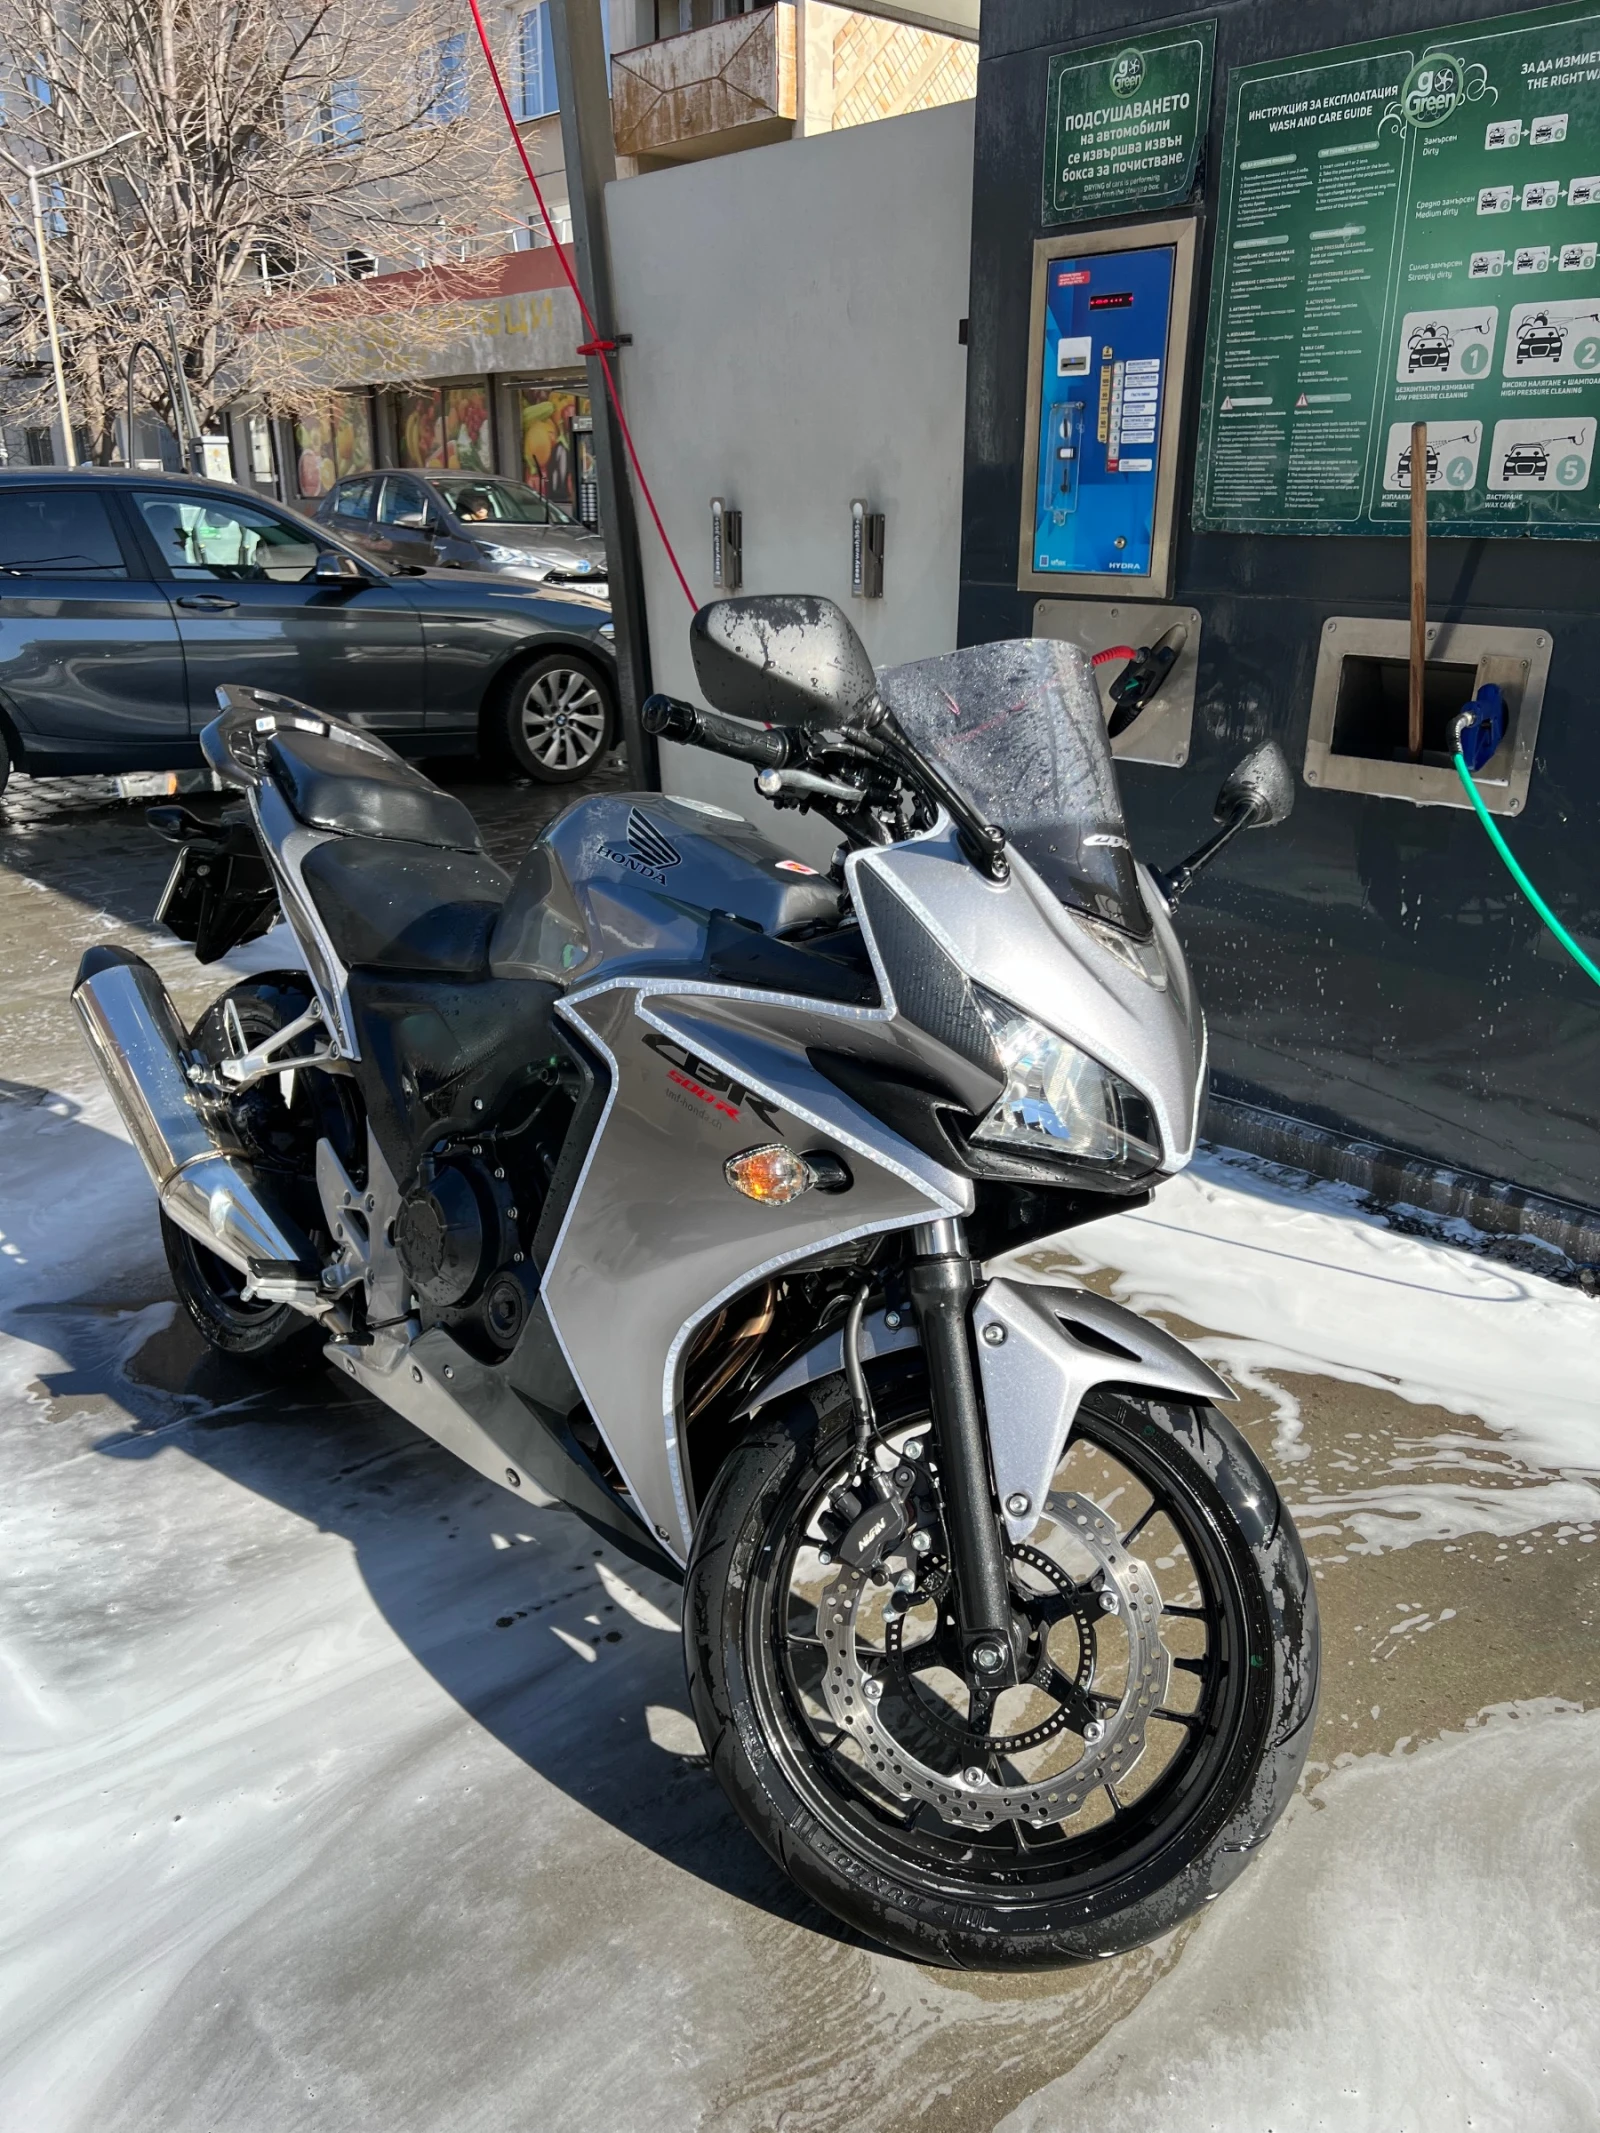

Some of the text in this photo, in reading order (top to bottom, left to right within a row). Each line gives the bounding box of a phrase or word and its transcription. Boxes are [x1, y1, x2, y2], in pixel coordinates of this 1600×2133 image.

[1521, 63, 1535, 75] ЗА
[1537, 59, 1553, 73] ДА
[1527, 77, 1548, 91] THE
[1550, 72, 1584, 87] RIGHT
[1065, 93, 1190, 132] ПОДСУШАВАНЕТО
[1248, 85, 1398, 121] ИНСТРУКЦИЯ ЗА ЕКСПЛОАТАЦИЯ
[1406, 91, 1456, 116] Green
[1269, 105, 1373, 133] WASH AND CARE GUIDE
[1080, 119, 1171, 146] на автомобили
[1423, 134, 1458, 146] Замърсен
[1067, 135, 1183, 165] се извършва извън
[1422, 147, 1440, 157] Dirty
[1062, 152, 1186, 183] бокса за почистване.
[1416, 195, 1476, 211] Средно замърсен
[1415, 207, 1459, 219] Medium dirty
[1409, 260, 1463, 272] Силно замърсен
[1437, 270, 1453, 280] dirty
[1469, 349, 1480, 369] 1
[1581, 342, 1597, 364] 2
[1500, 387, 1583, 397] HIGH PRESSURE CLEANING
[1502, 380, 1527, 389] ВИСОКО
[1528, 379, 1562, 388] НАЛЯГАНЕ
[1394, 391, 1468, 401] LOW PRESSURE CLEANING
[1452, 462, 1466, 481] 4
[1563, 460, 1578, 480] 5
[1108, 561, 1141, 570] HYDRA
[596, 845, 668, 886] HONDA
